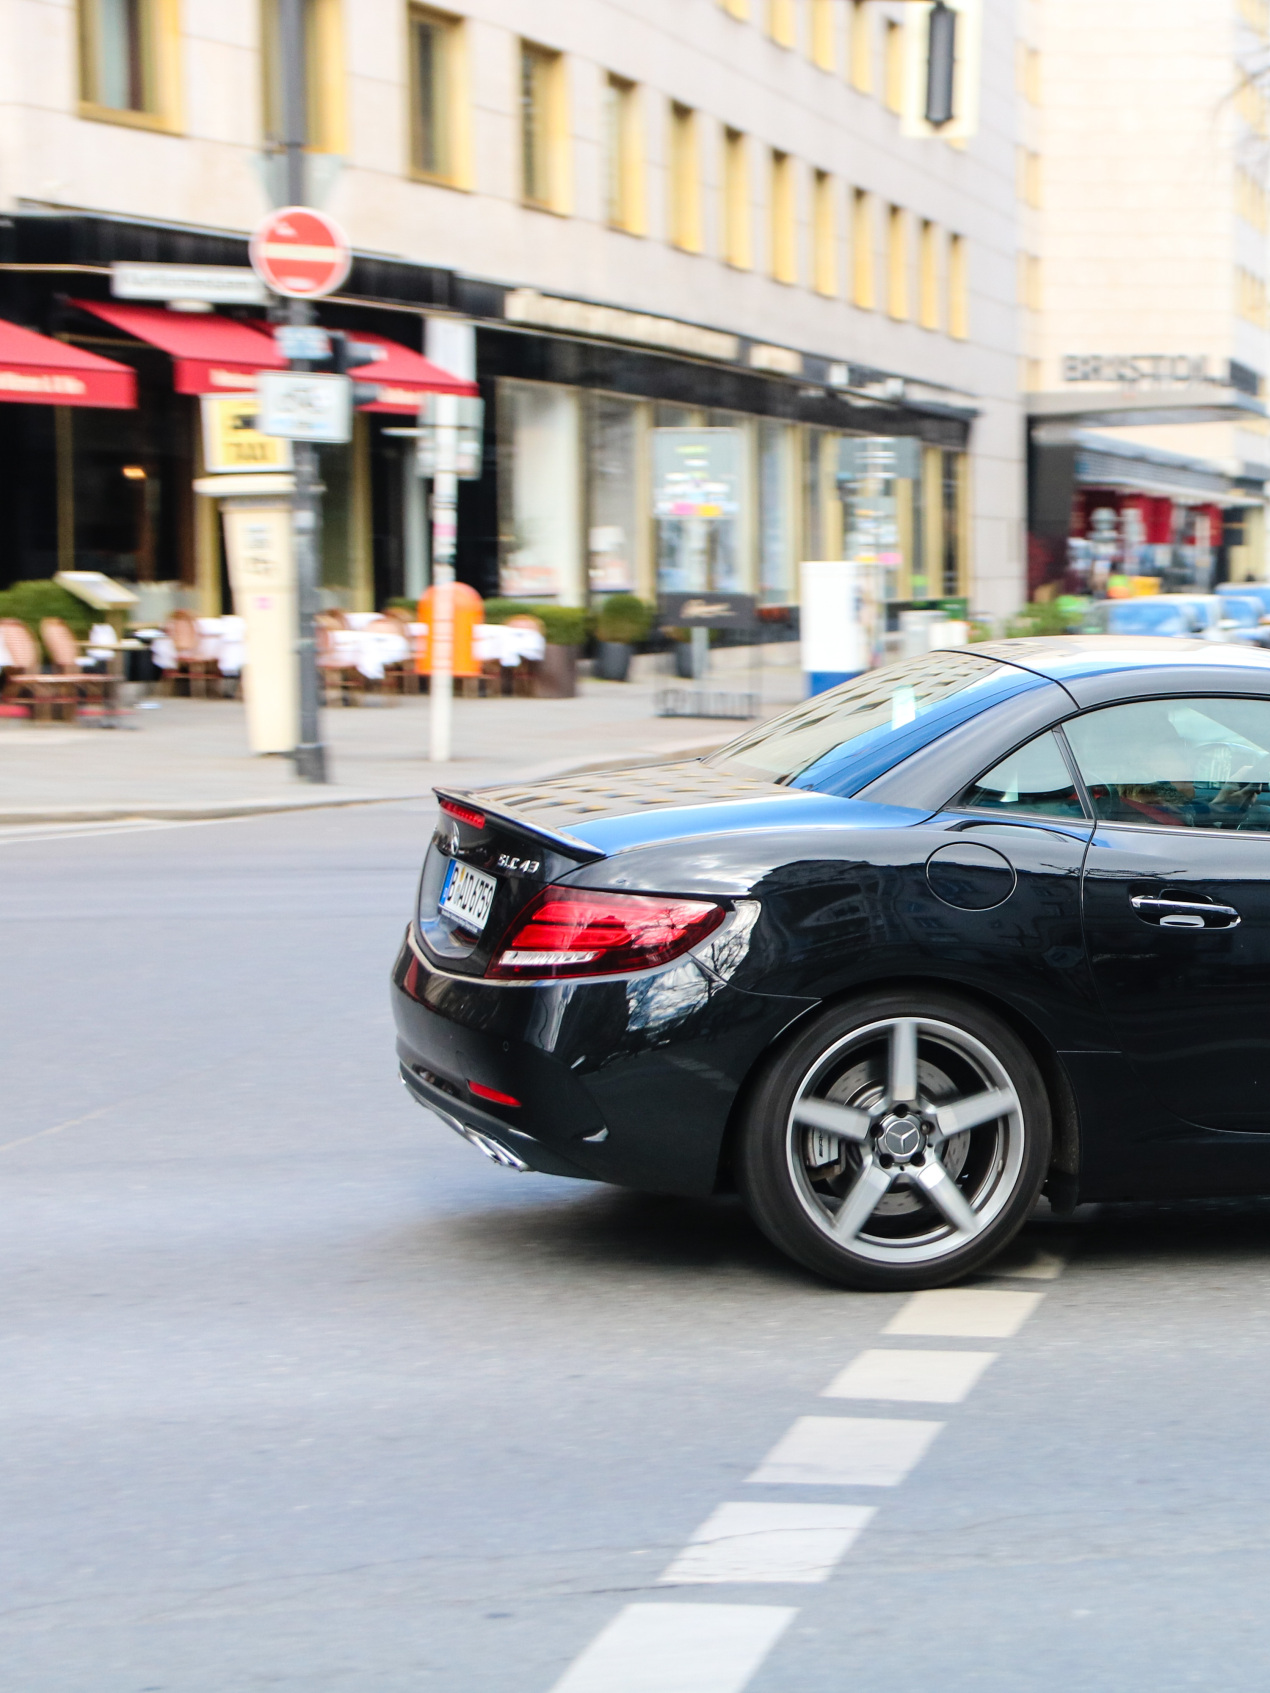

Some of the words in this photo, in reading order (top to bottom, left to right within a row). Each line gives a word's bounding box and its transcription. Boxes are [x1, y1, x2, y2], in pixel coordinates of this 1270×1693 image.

[1062, 354, 1230, 388] BRISTOL
[498, 854, 520, 870] SLC
[520, 859, 540, 874] 43
